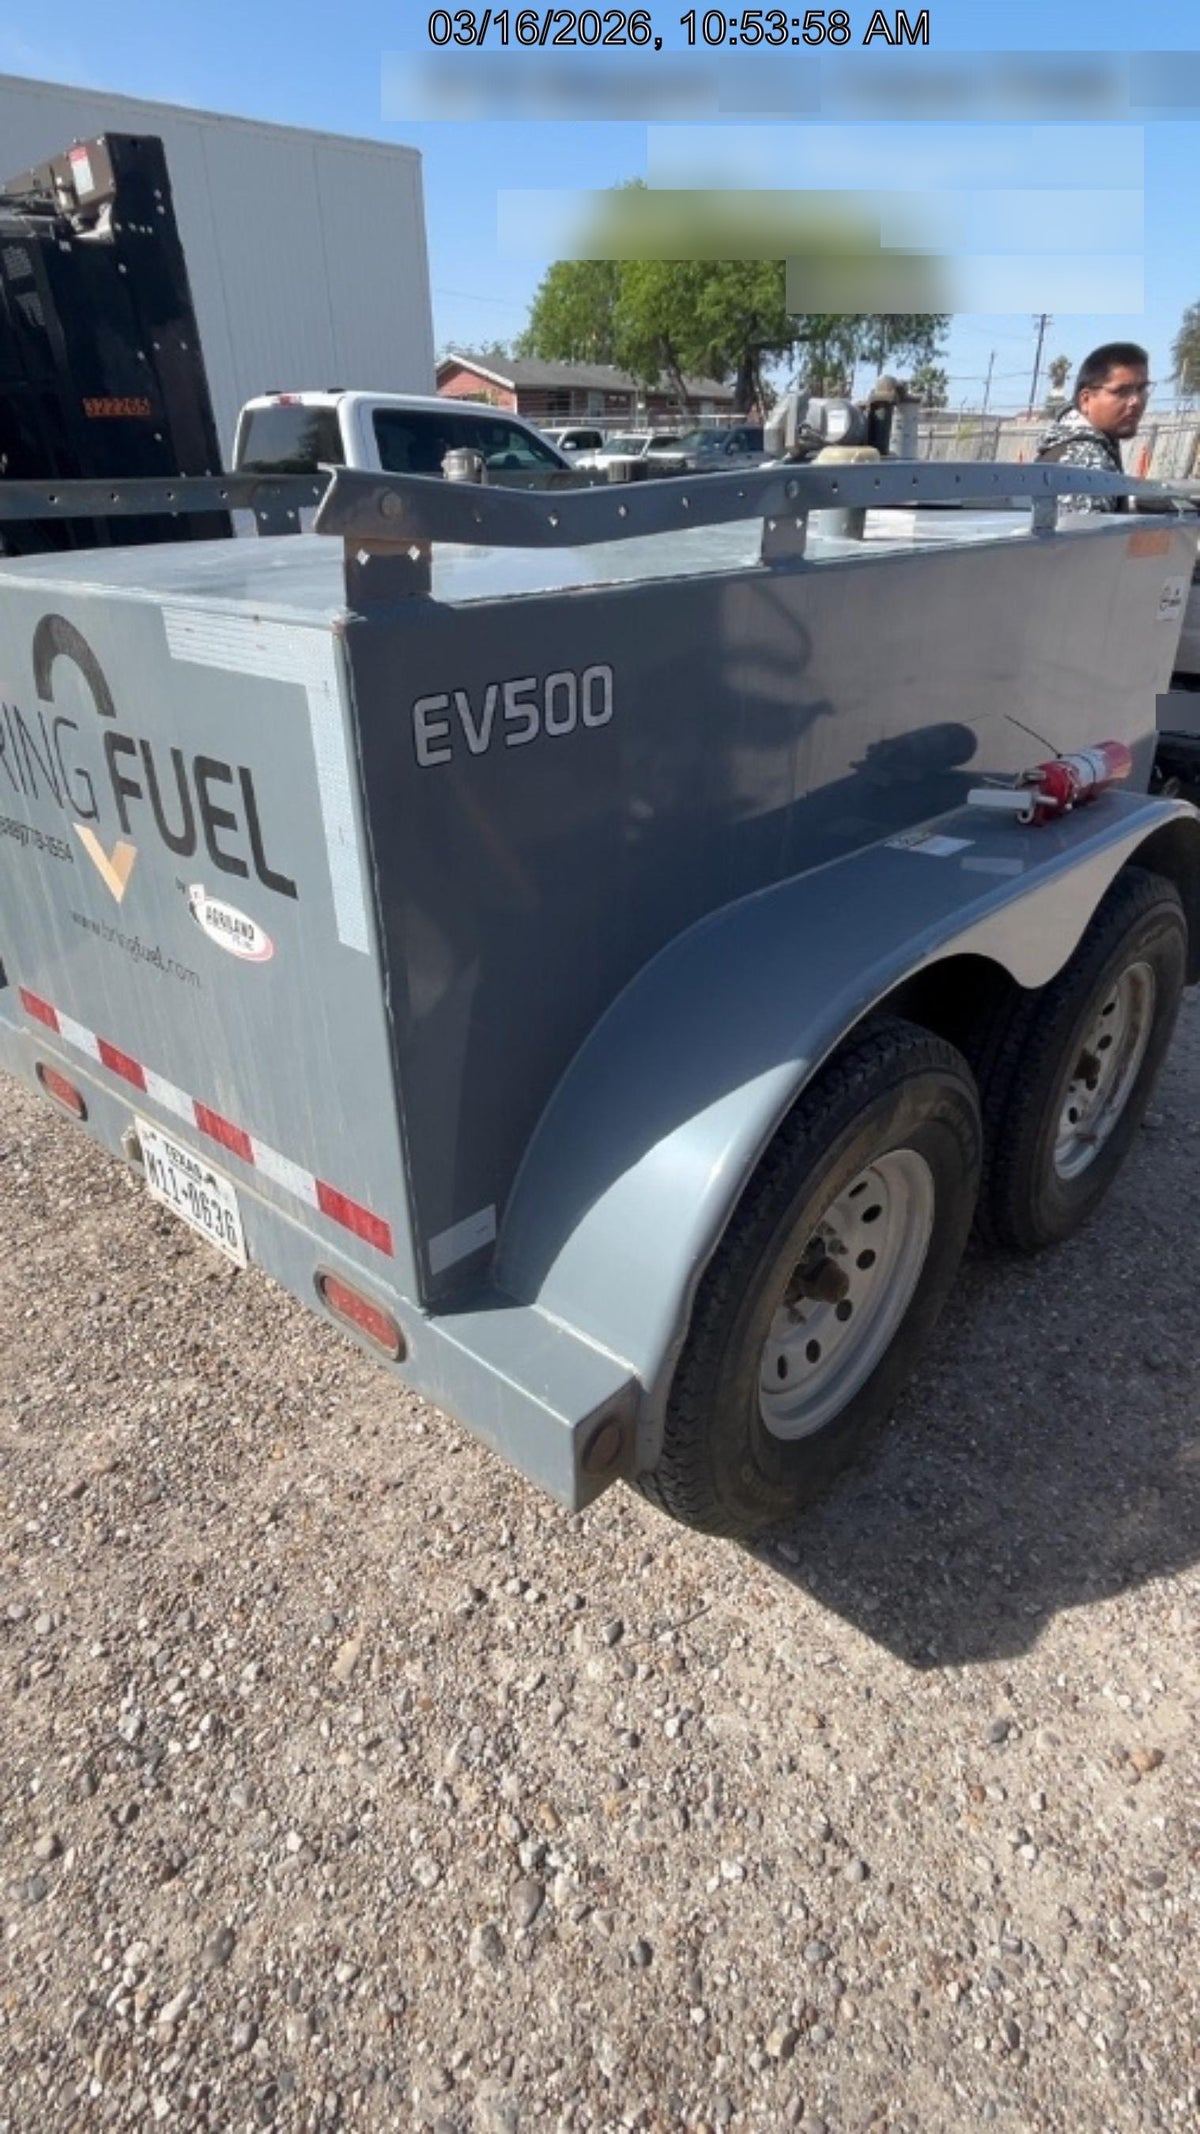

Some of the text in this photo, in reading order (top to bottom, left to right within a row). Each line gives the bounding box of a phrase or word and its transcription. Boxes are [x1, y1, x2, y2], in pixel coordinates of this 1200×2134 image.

[412, 664, 613, 768] EV500
[104, 729, 298, 900] FUEL
[68, 909, 201, 988] www.bringfuel.com
[163, 1140, 203, 1181] TEXAS
